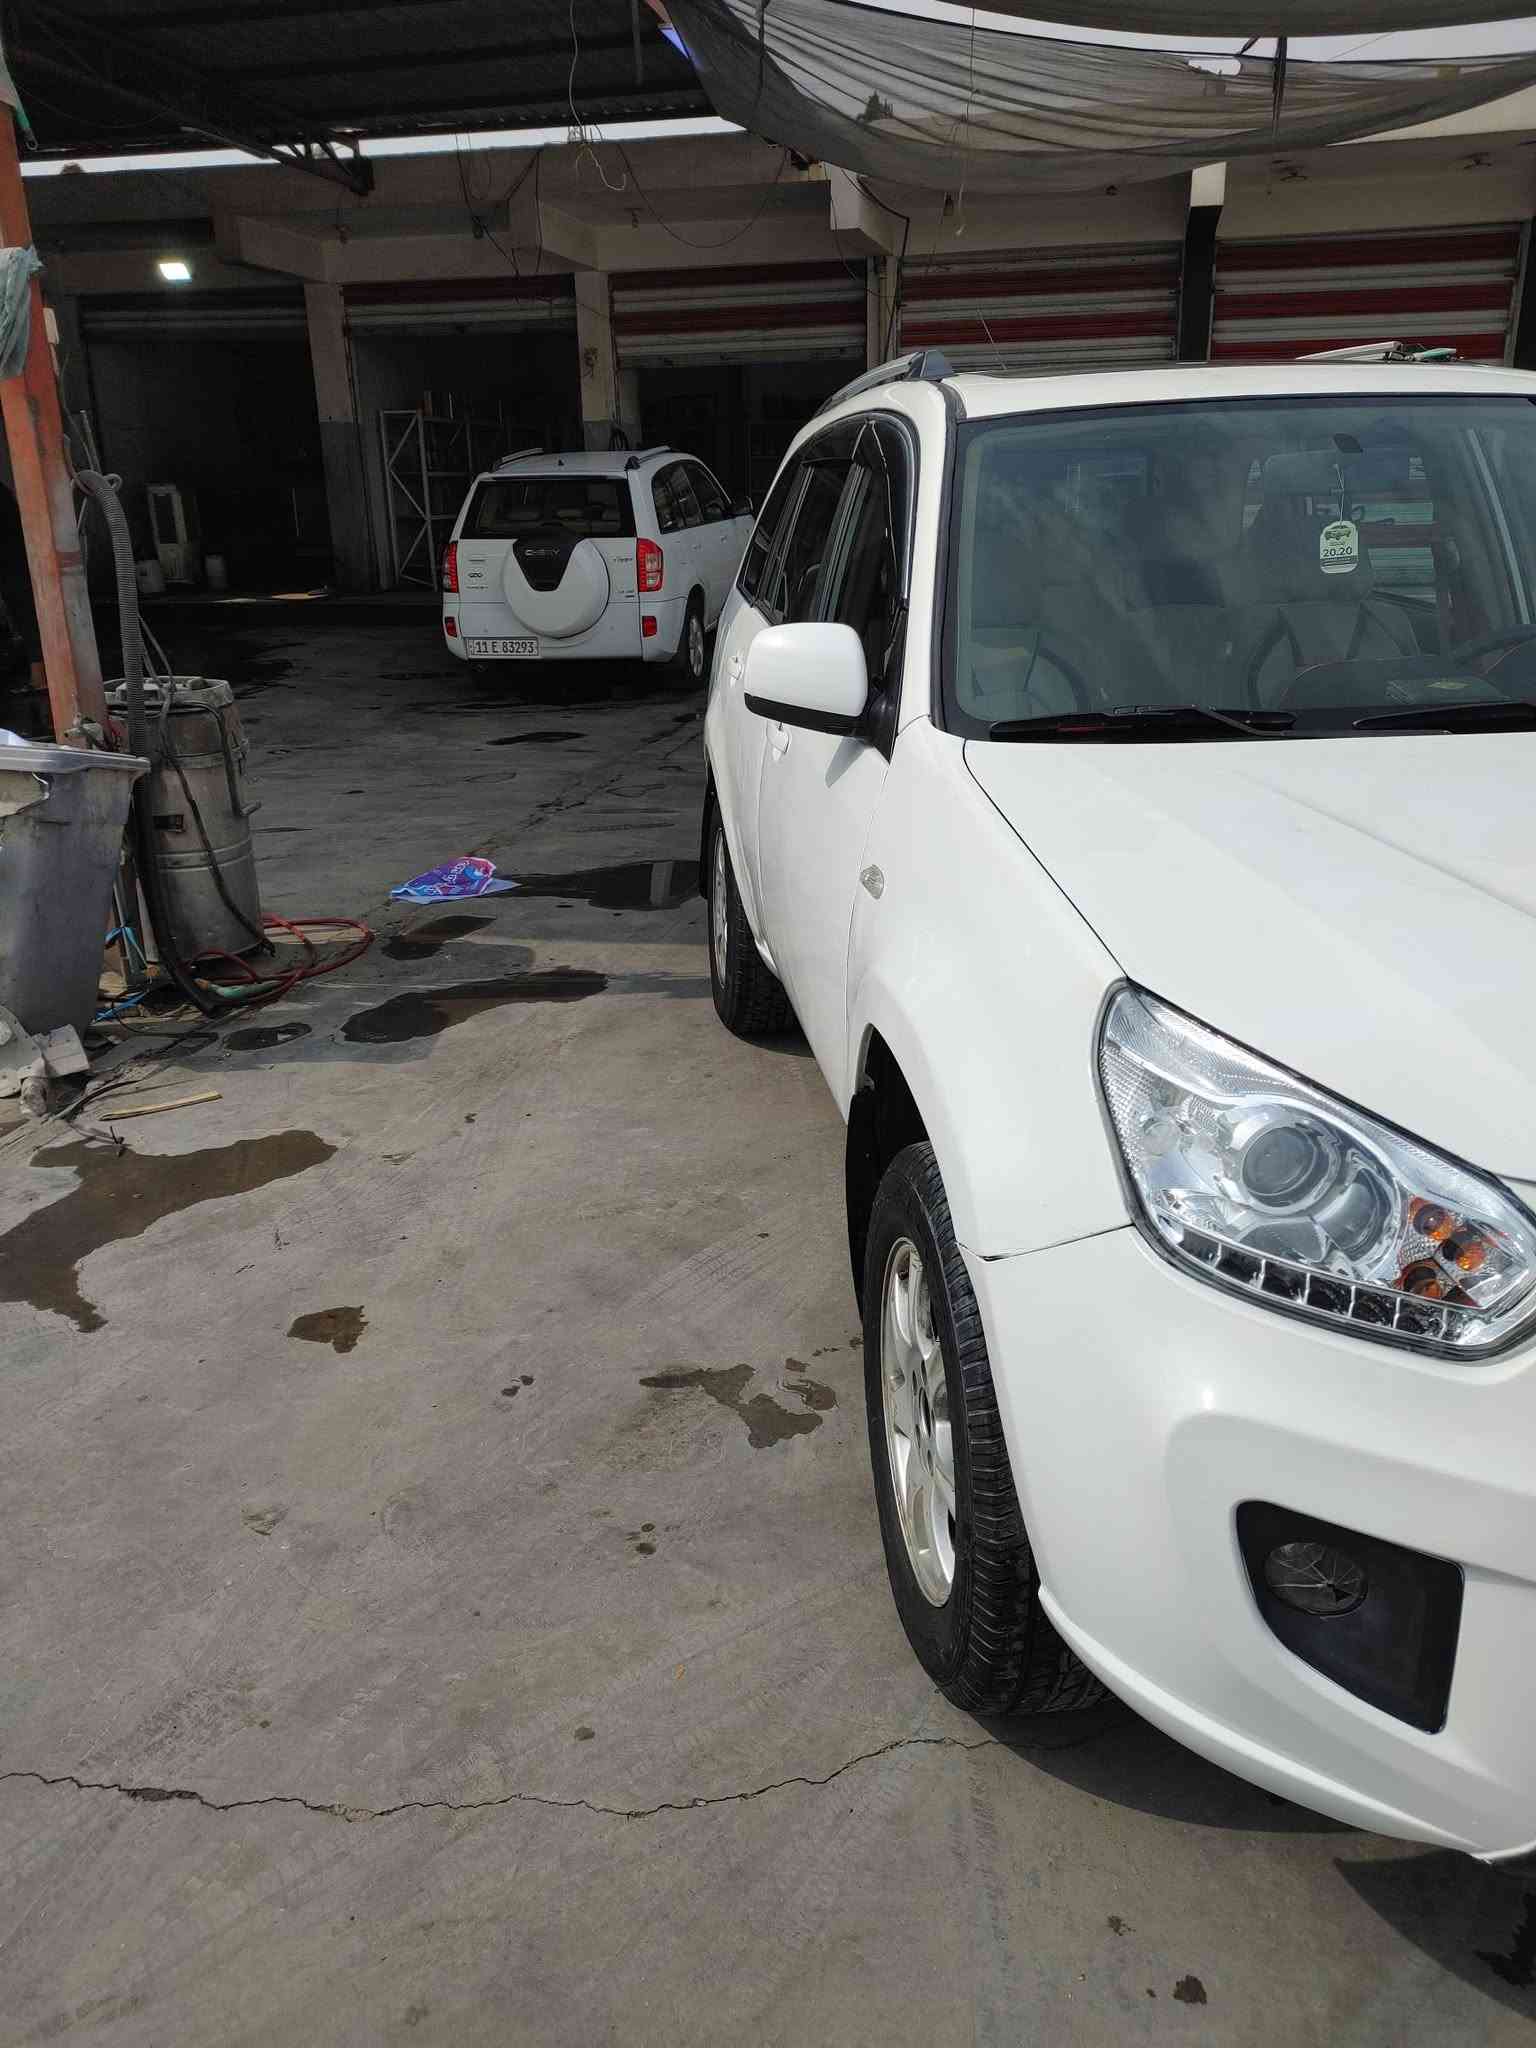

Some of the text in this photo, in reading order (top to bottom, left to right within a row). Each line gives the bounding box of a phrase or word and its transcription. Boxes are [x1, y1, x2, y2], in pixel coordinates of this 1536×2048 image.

[475, 641, 488, 653] 11
[491, 641, 499, 653] E
[502, 641, 534, 654] 83293
